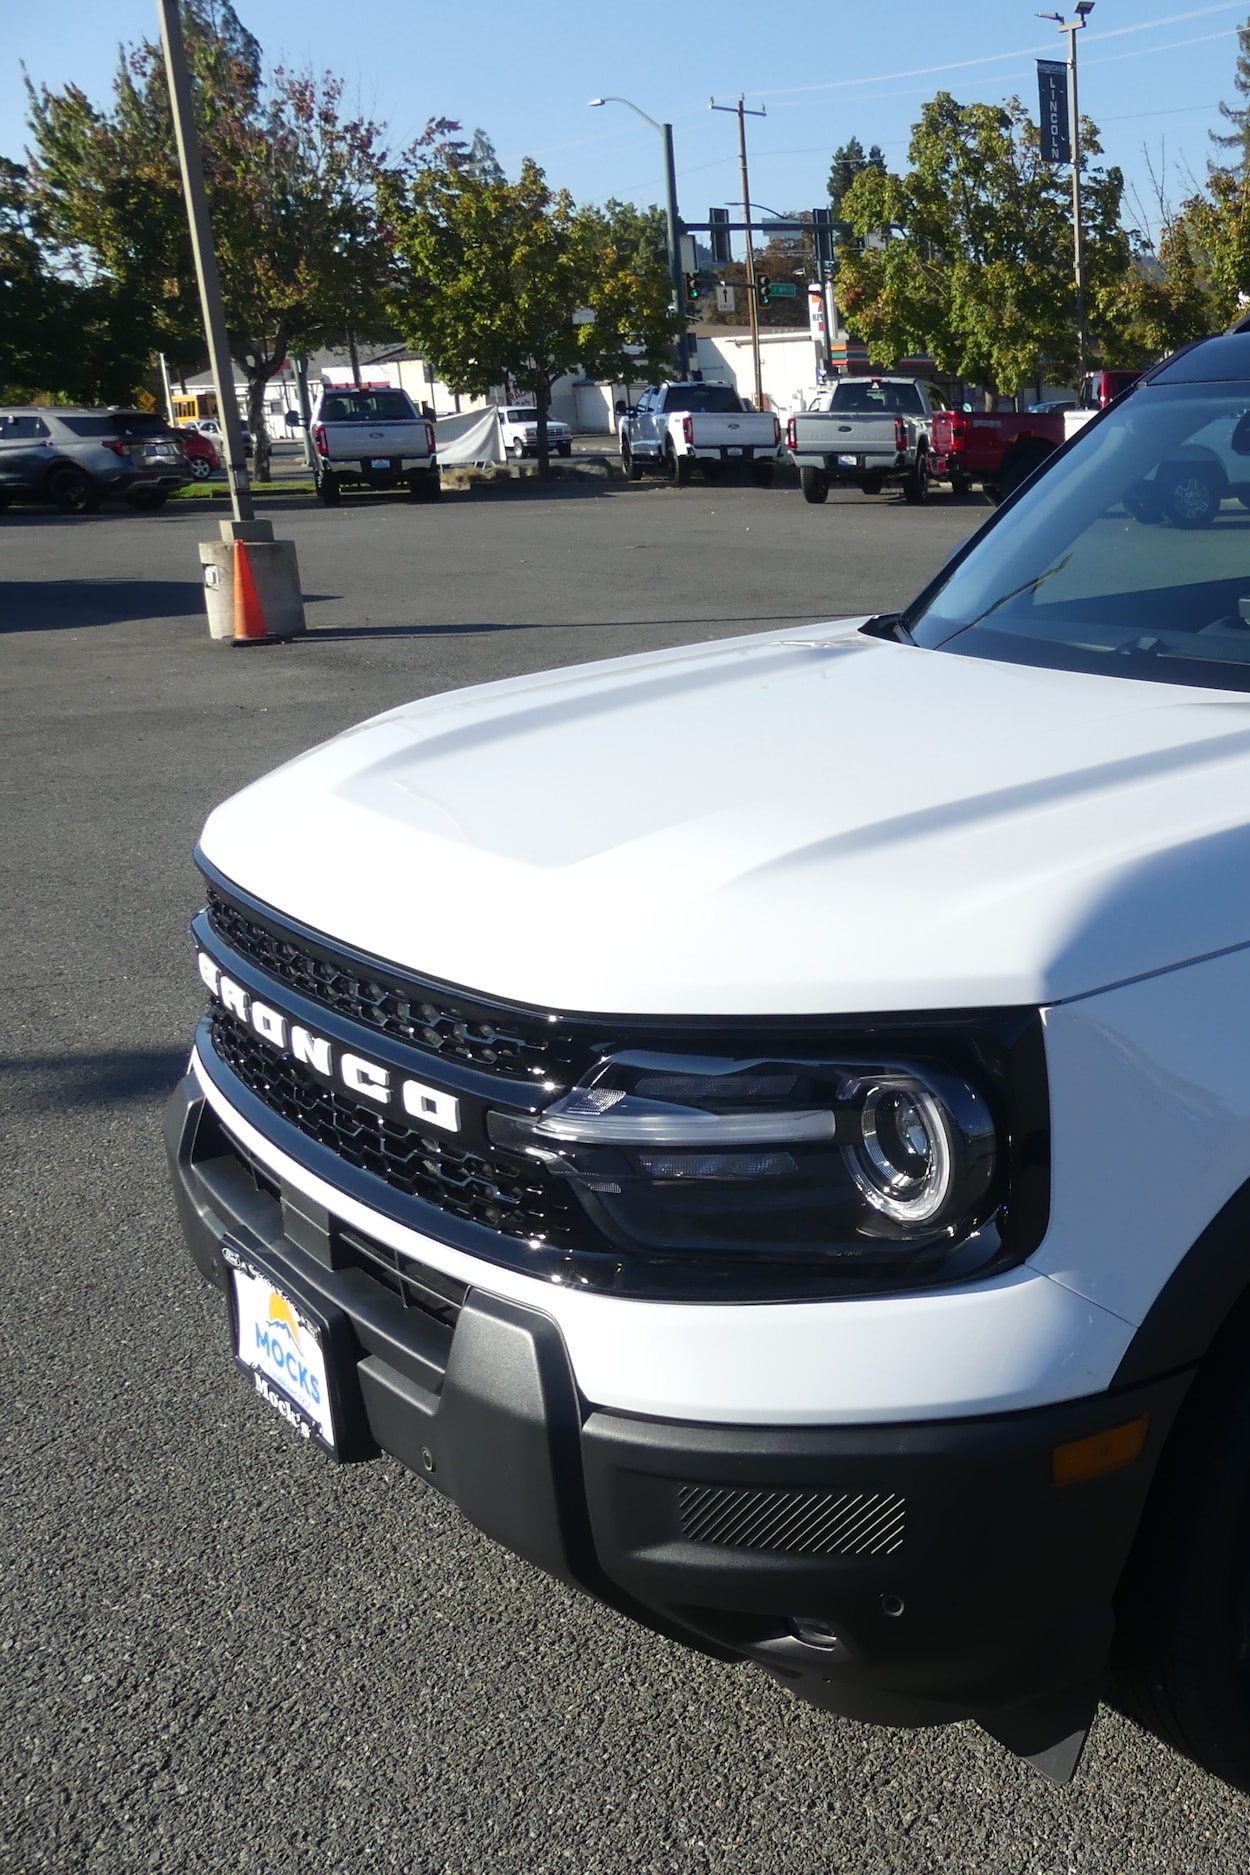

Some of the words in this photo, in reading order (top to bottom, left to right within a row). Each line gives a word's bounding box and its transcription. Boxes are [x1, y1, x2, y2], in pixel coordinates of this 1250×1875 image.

[1049, 77, 1059, 159] LINCOLN
[198, 952, 462, 1132] BRONCO
[254, 1321, 320, 1404] MOCKS
[254, 1372, 311, 1438] Mock's
